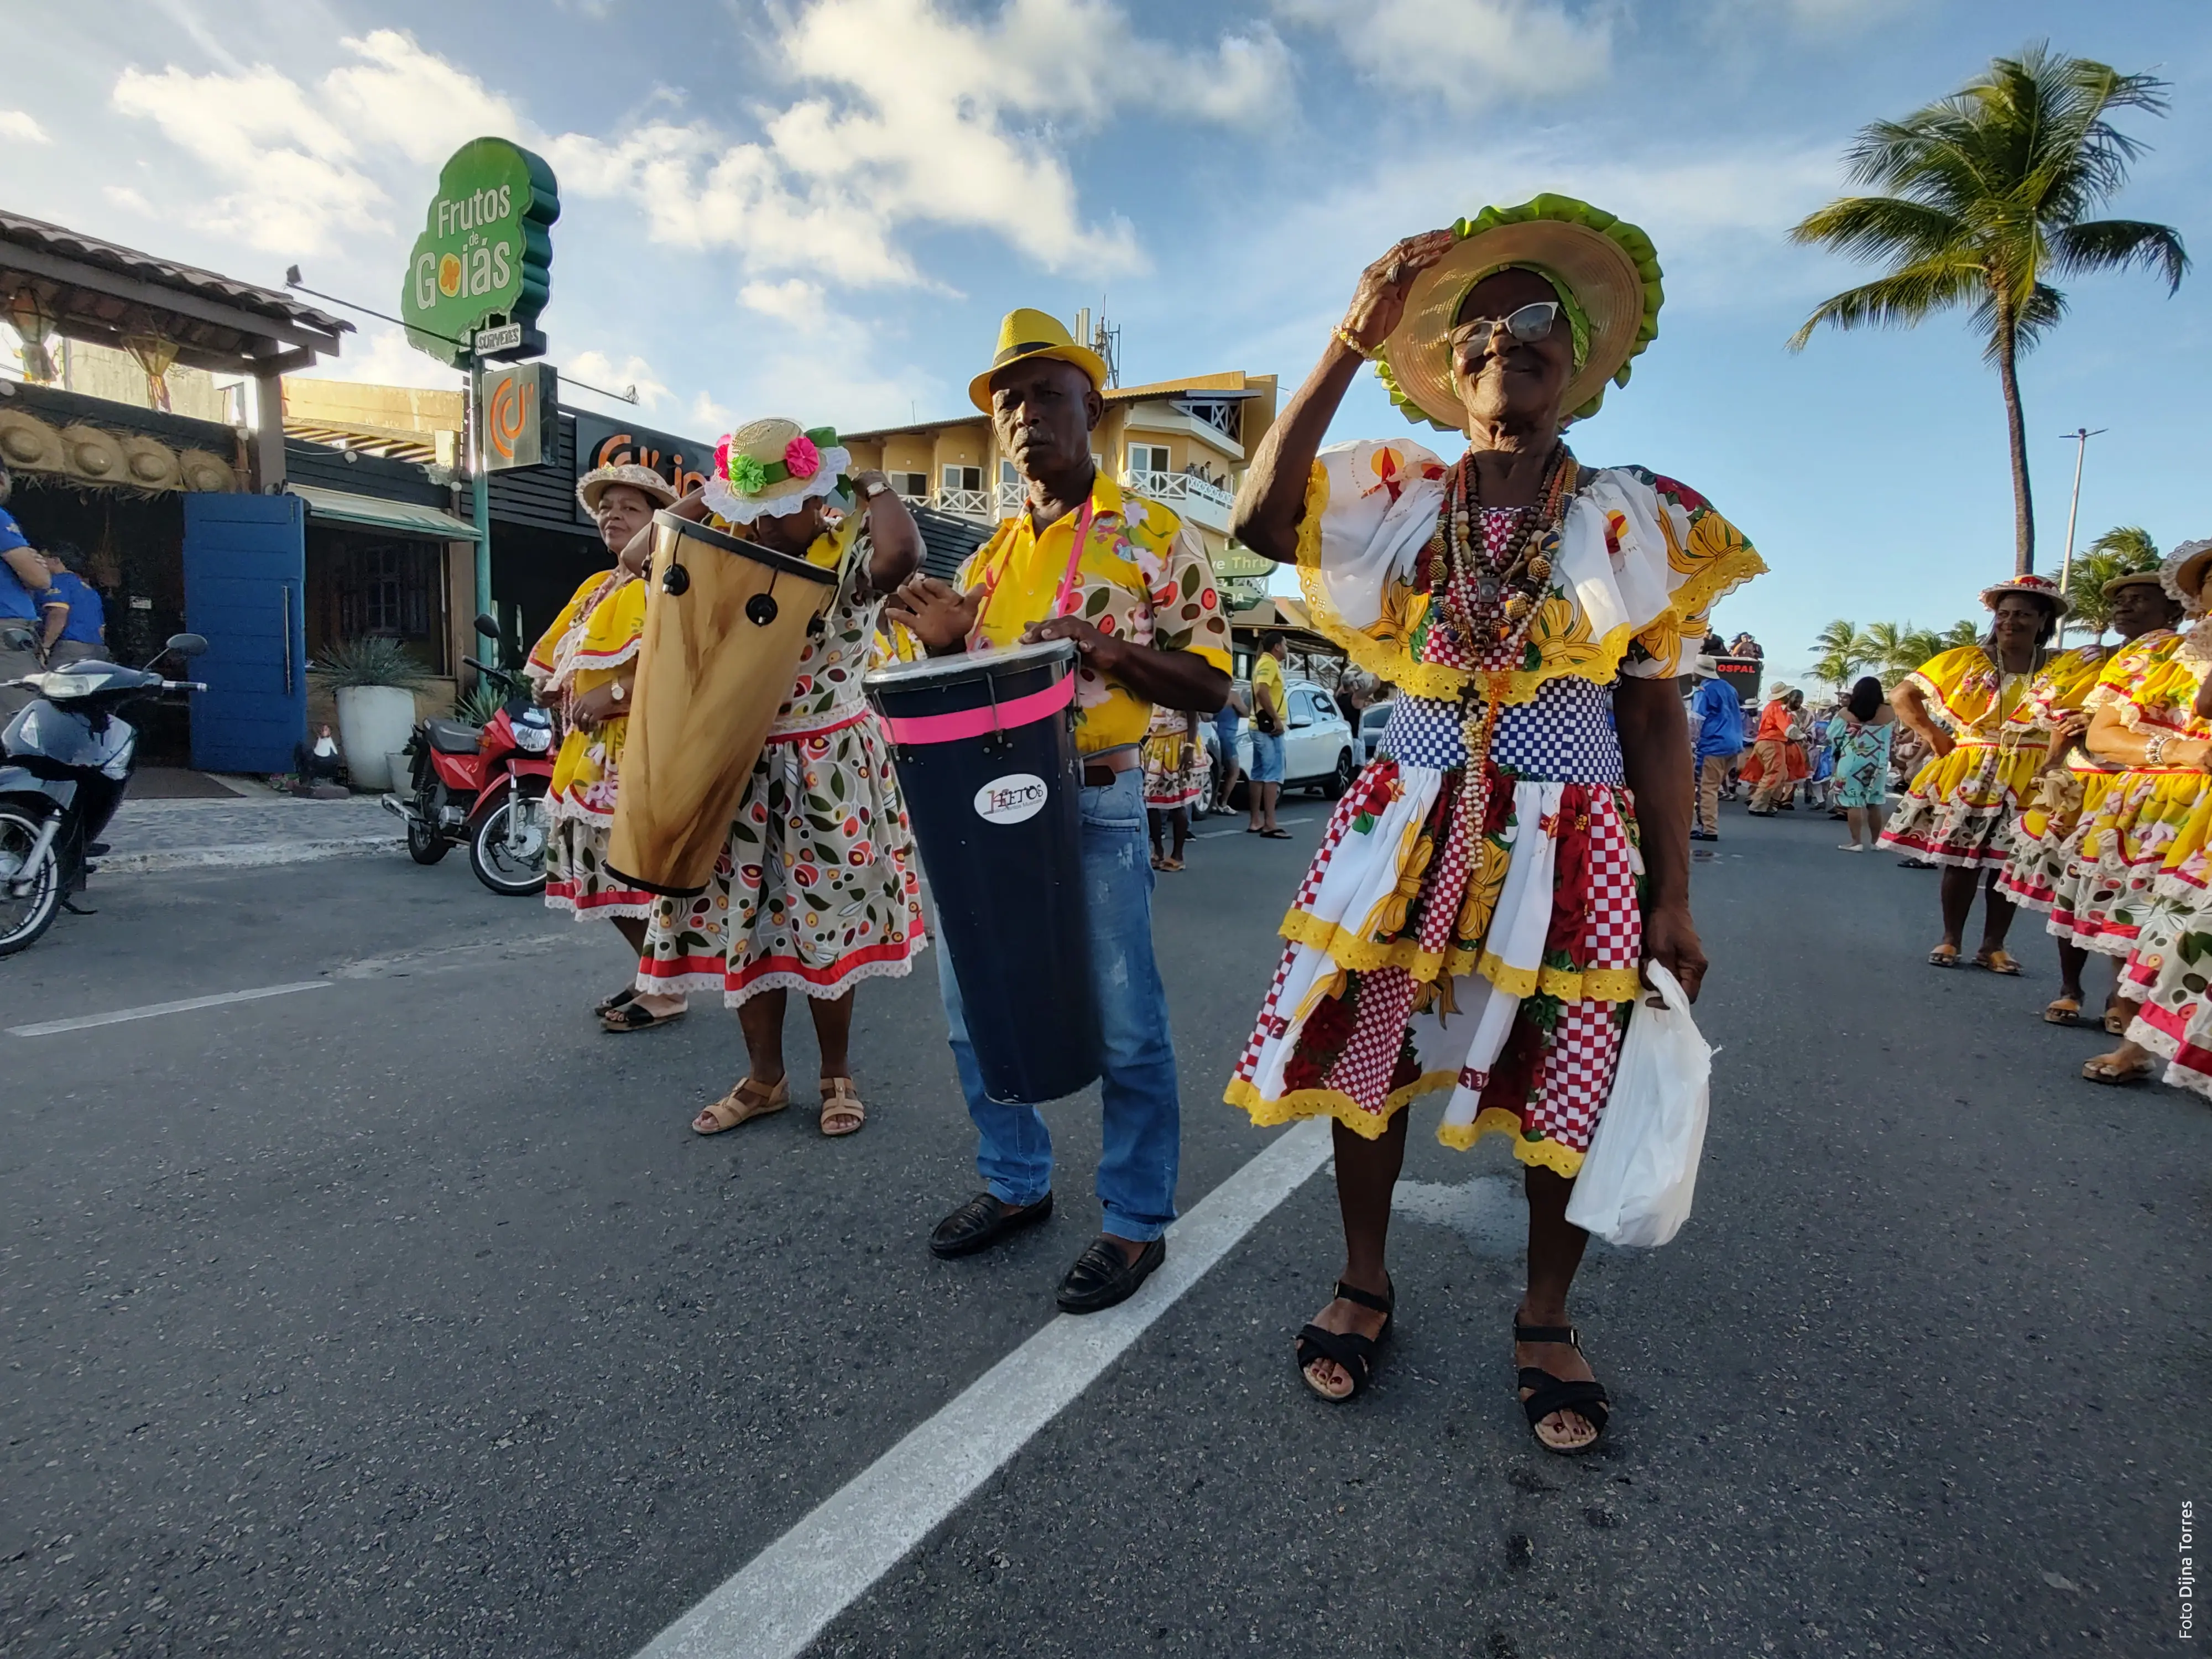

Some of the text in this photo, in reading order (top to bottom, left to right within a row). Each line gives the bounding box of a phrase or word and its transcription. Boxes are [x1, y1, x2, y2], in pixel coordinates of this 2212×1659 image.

[438, 185, 511, 239] Frutos
[469, 231, 479, 247] de
[416, 237, 511, 310] Goiás
[1231, 556, 1269, 569] Thru
